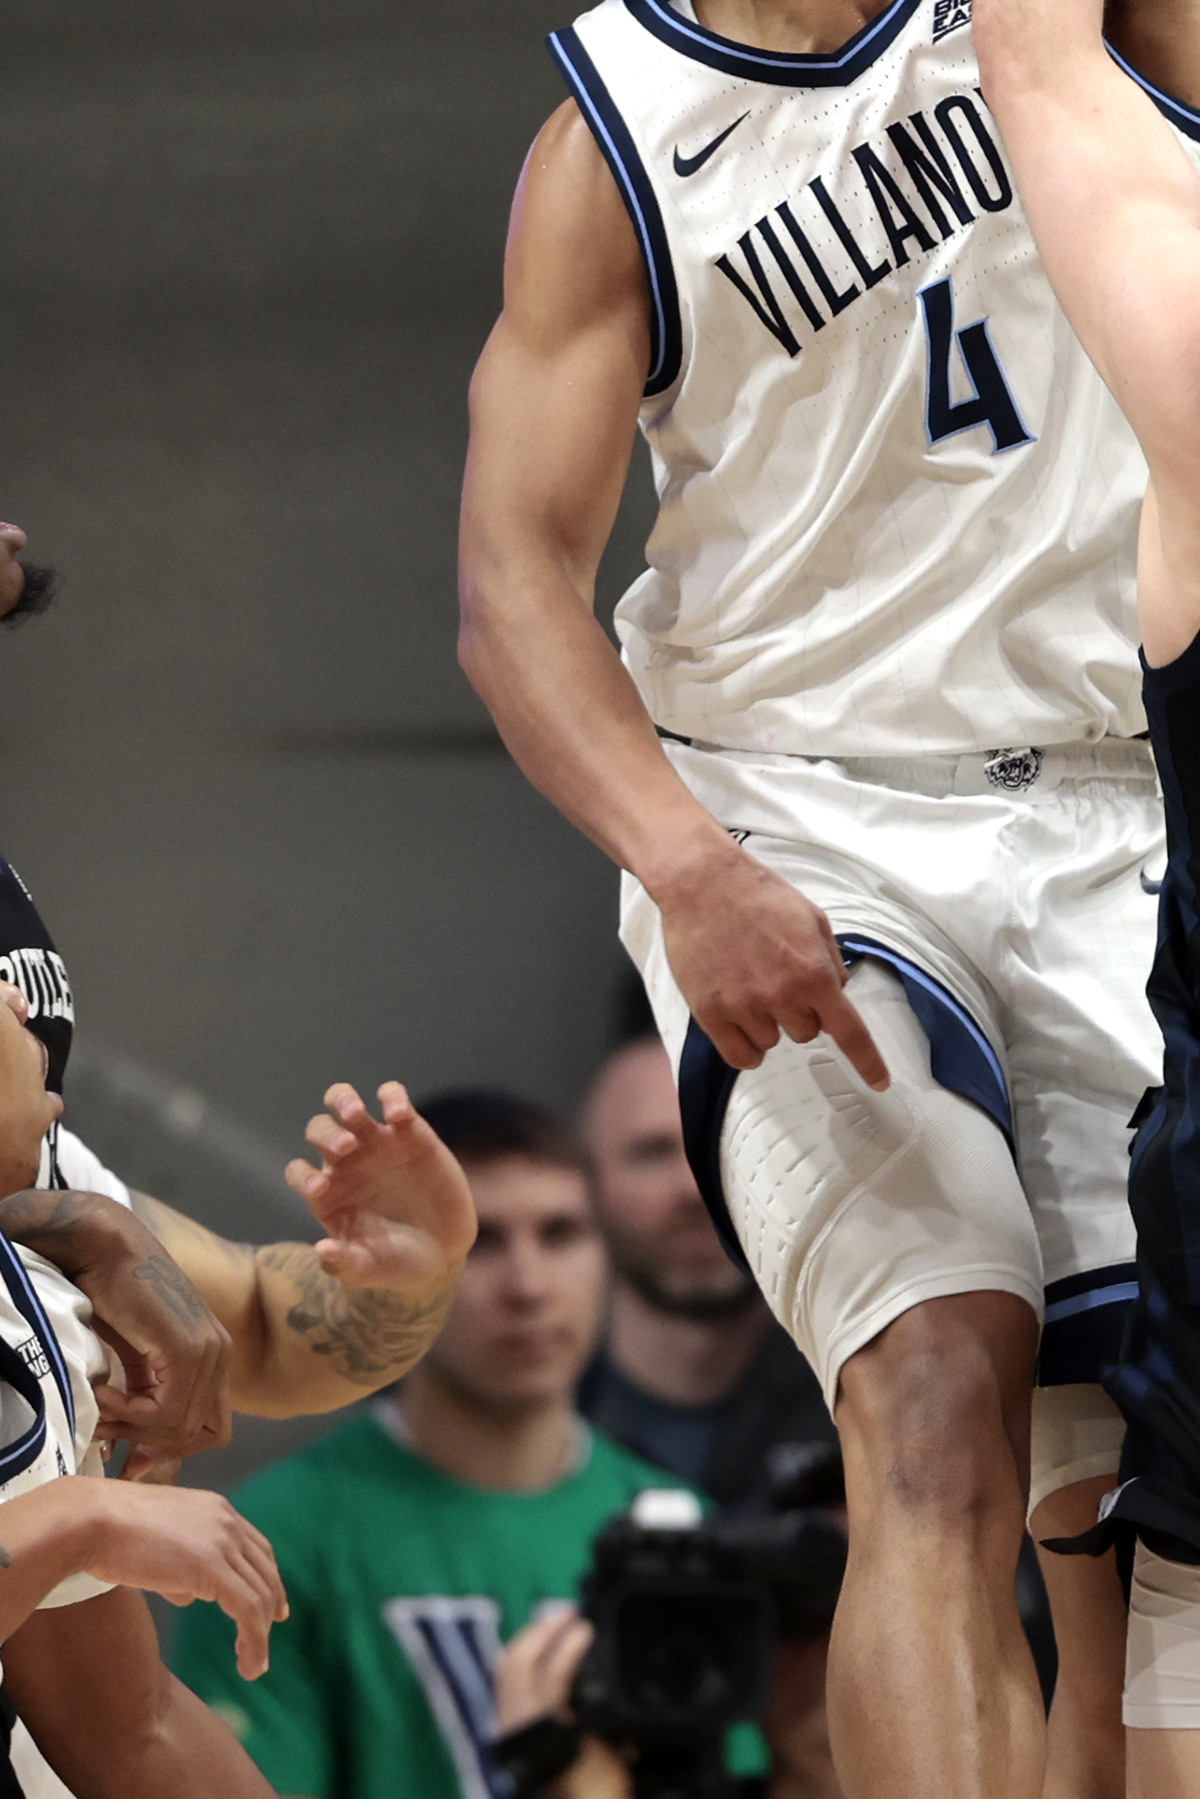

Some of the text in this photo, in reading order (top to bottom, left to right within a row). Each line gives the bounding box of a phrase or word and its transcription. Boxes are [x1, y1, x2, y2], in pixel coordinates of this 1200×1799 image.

[932, 2, 973, 35] EA
[715, 88, 1013, 358] VILLANO
[916, 275, 1038, 455] 4
